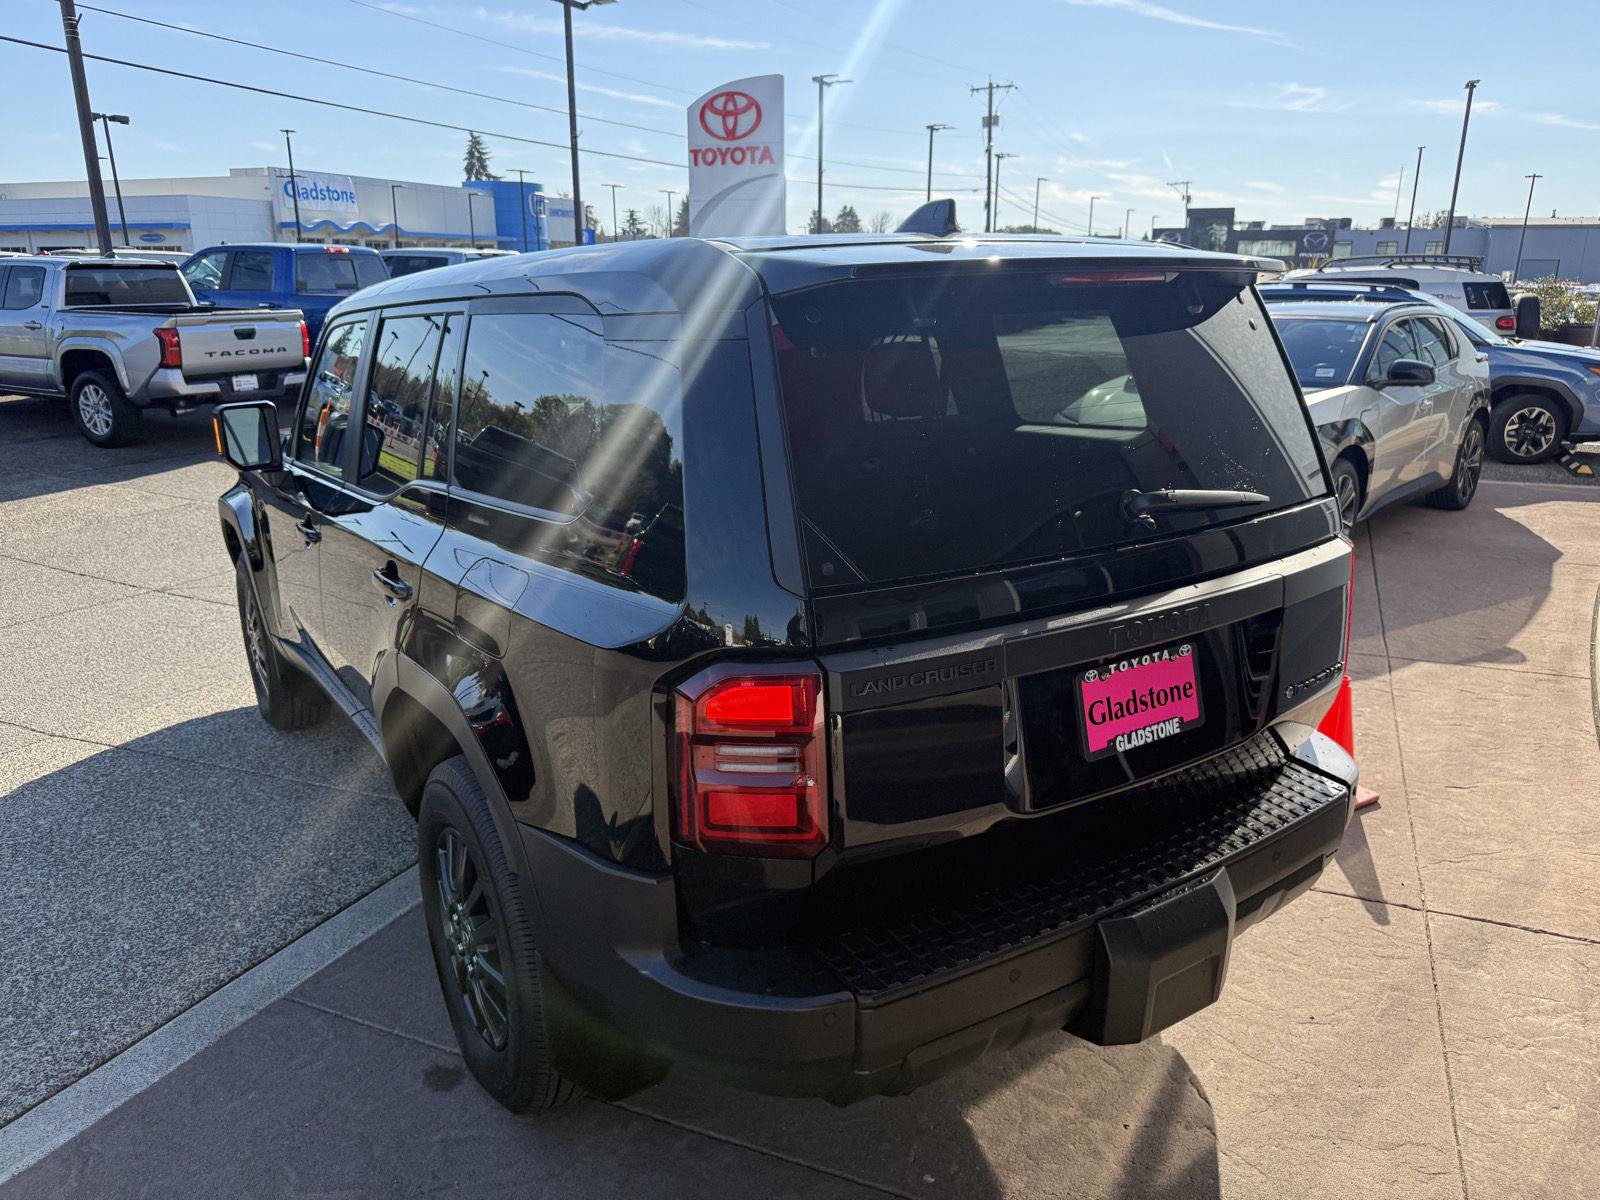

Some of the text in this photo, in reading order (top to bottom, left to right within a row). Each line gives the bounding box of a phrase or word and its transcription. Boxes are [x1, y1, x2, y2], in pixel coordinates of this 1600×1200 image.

[689, 145, 775, 167] TOYOTA
[283, 180, 356, 204] Gladstone
[204, 346, 287, 358] TACOMA
[1109, 603, 1211, 650] TOYOTA
[851, 657, 997, 697] LAND CRUISER
[1109, 649, 1170, 675] TOYOTA
[1088, 681, 1194, 726] Gladstone
[1116, 717, 1181, 752] GLADSTONE
